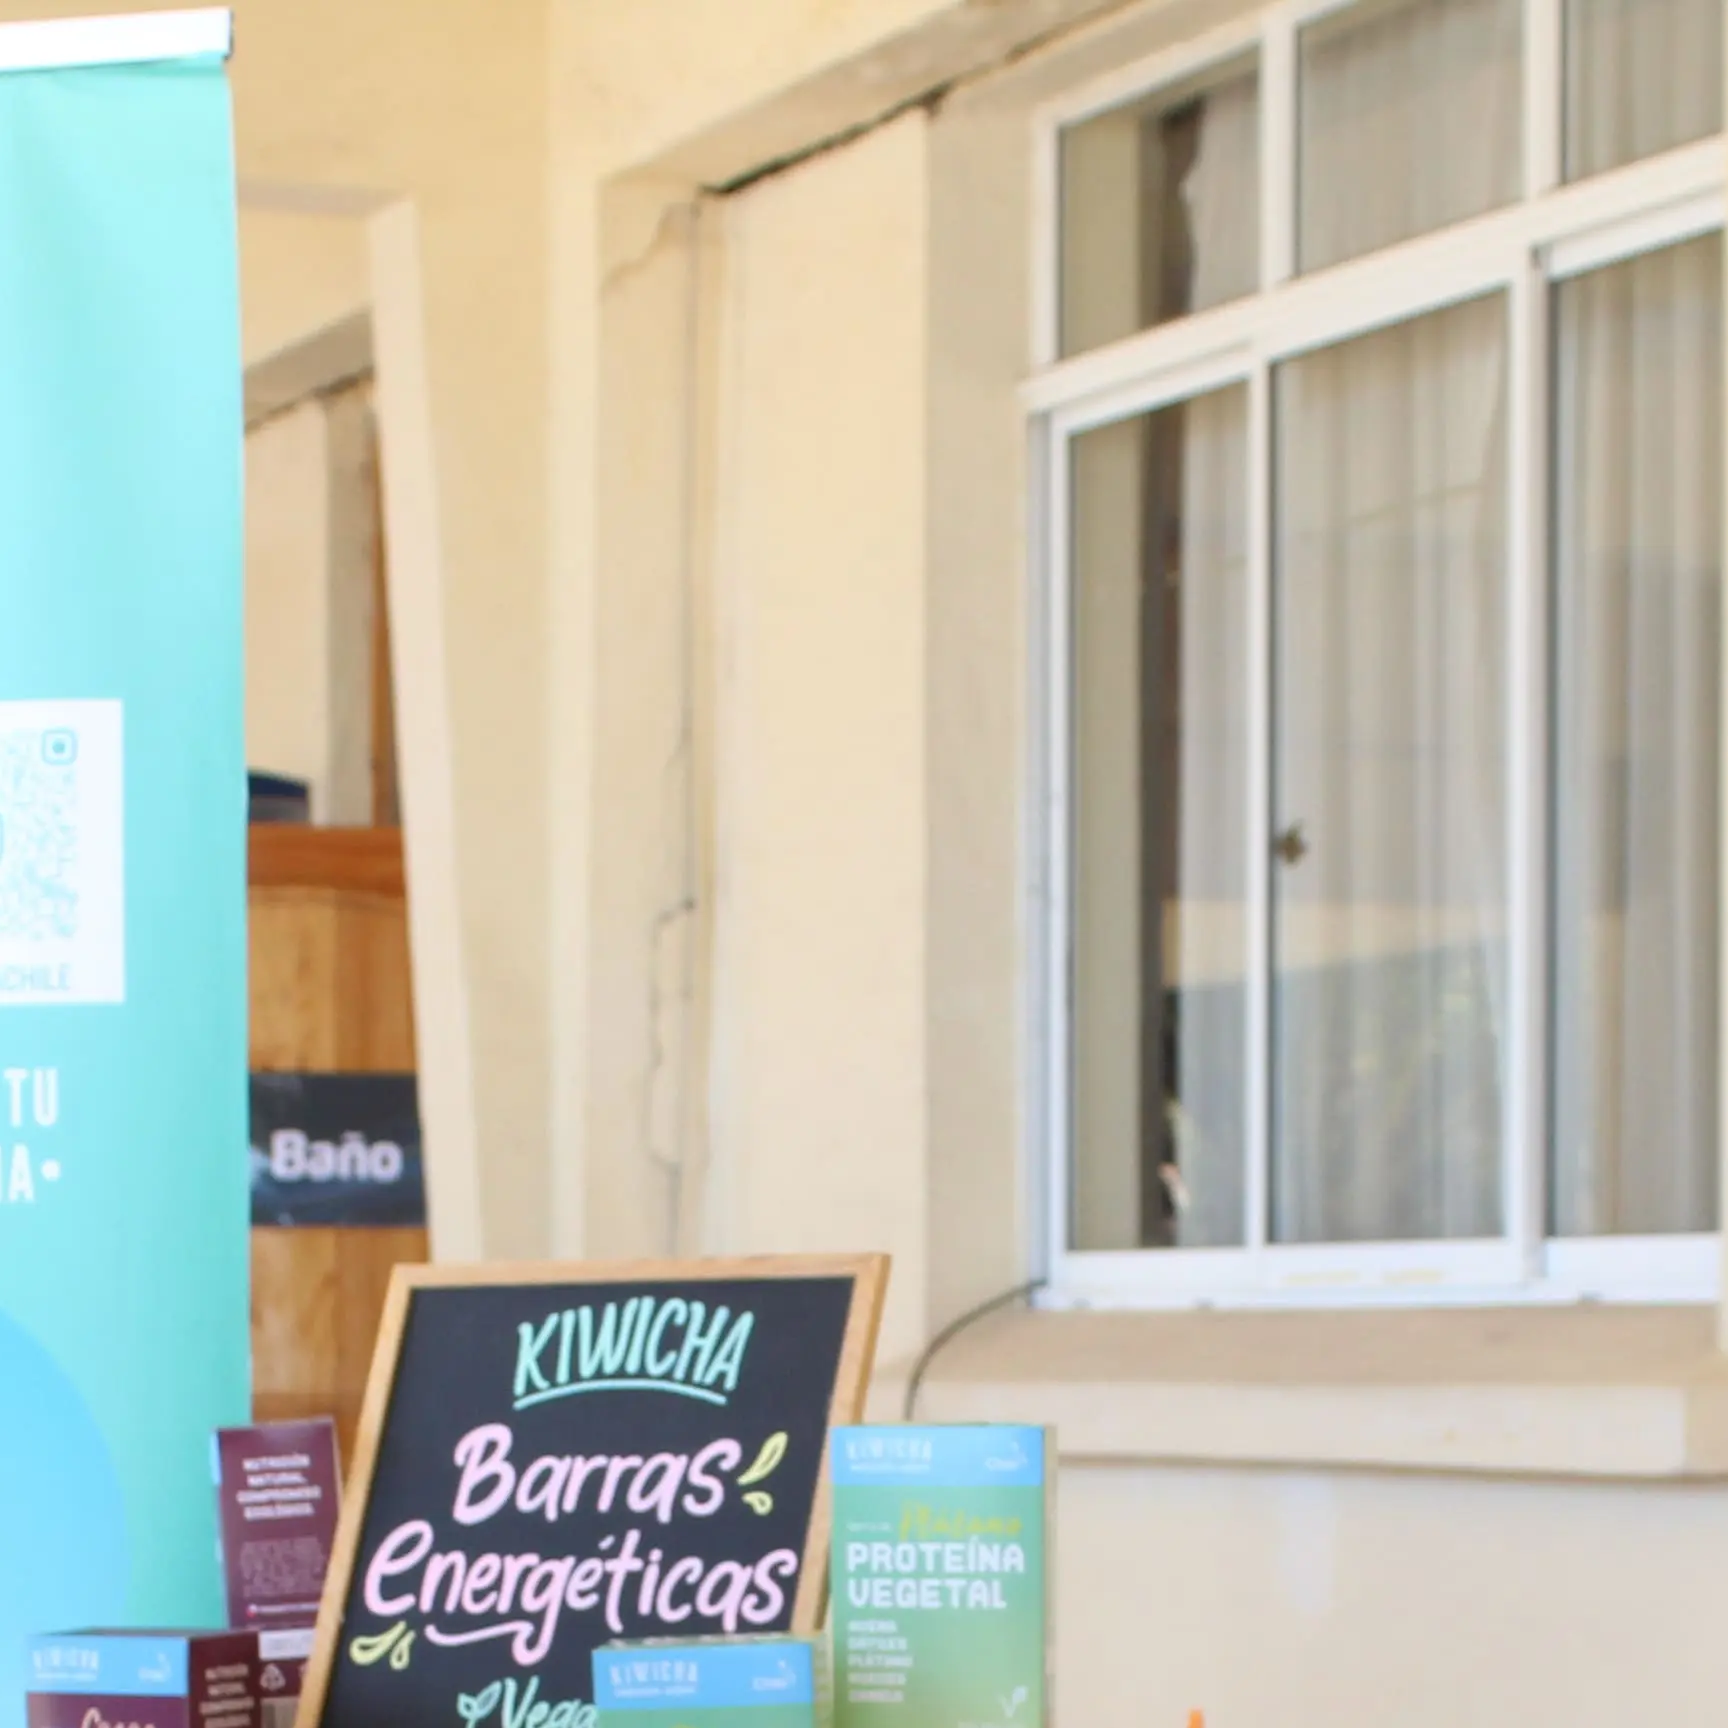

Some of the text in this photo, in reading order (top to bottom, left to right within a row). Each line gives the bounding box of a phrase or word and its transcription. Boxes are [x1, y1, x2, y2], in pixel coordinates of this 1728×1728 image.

[4, 1068, 58, 1127] TU
[270, 1129, 403, 1183] Baño
[513, 1297, 755, 1395] KIWICHA
[453, 1424, 743, 1524] Barras
[846, 1535, 1025, 1573] PROTEÍNA
[848, 1578, 1007, 1609] VEGETAL
